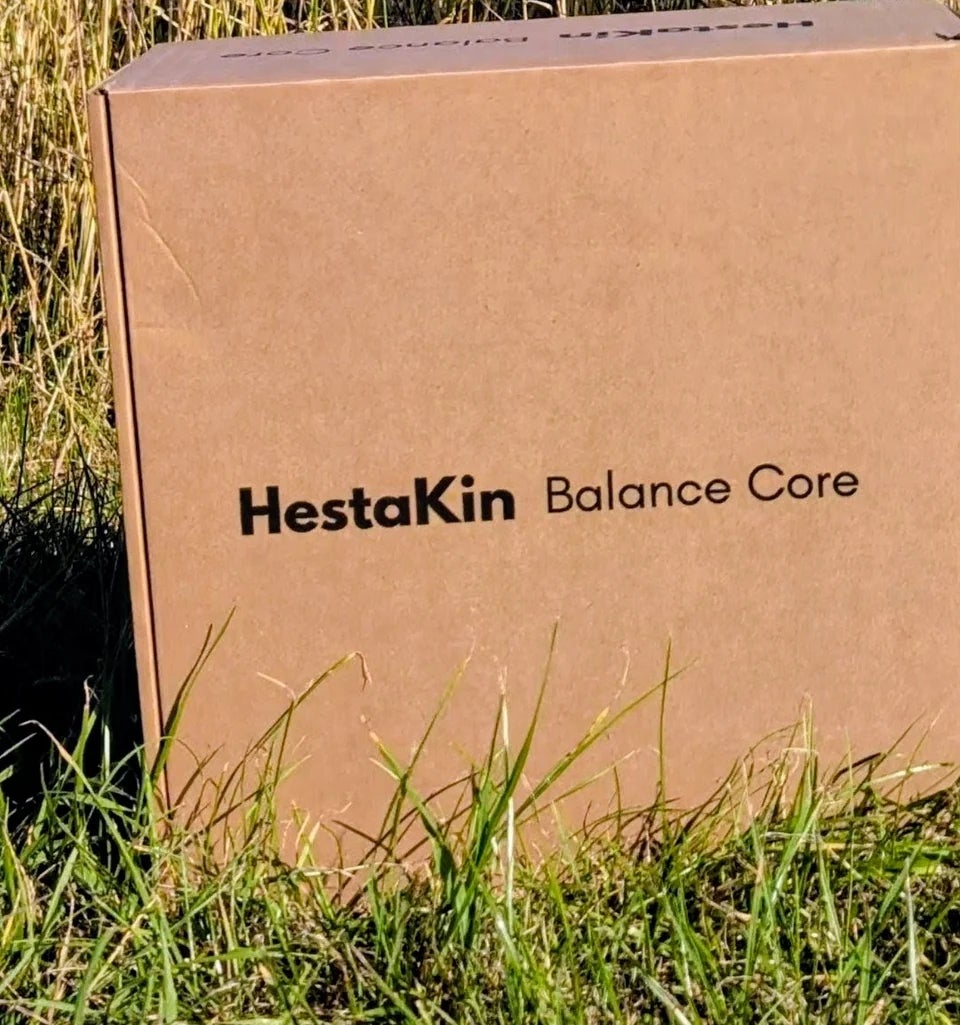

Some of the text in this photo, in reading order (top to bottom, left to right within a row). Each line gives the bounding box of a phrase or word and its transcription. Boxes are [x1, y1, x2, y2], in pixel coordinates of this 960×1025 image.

[239, 463, 859, 536] HestaKin Balance Core
